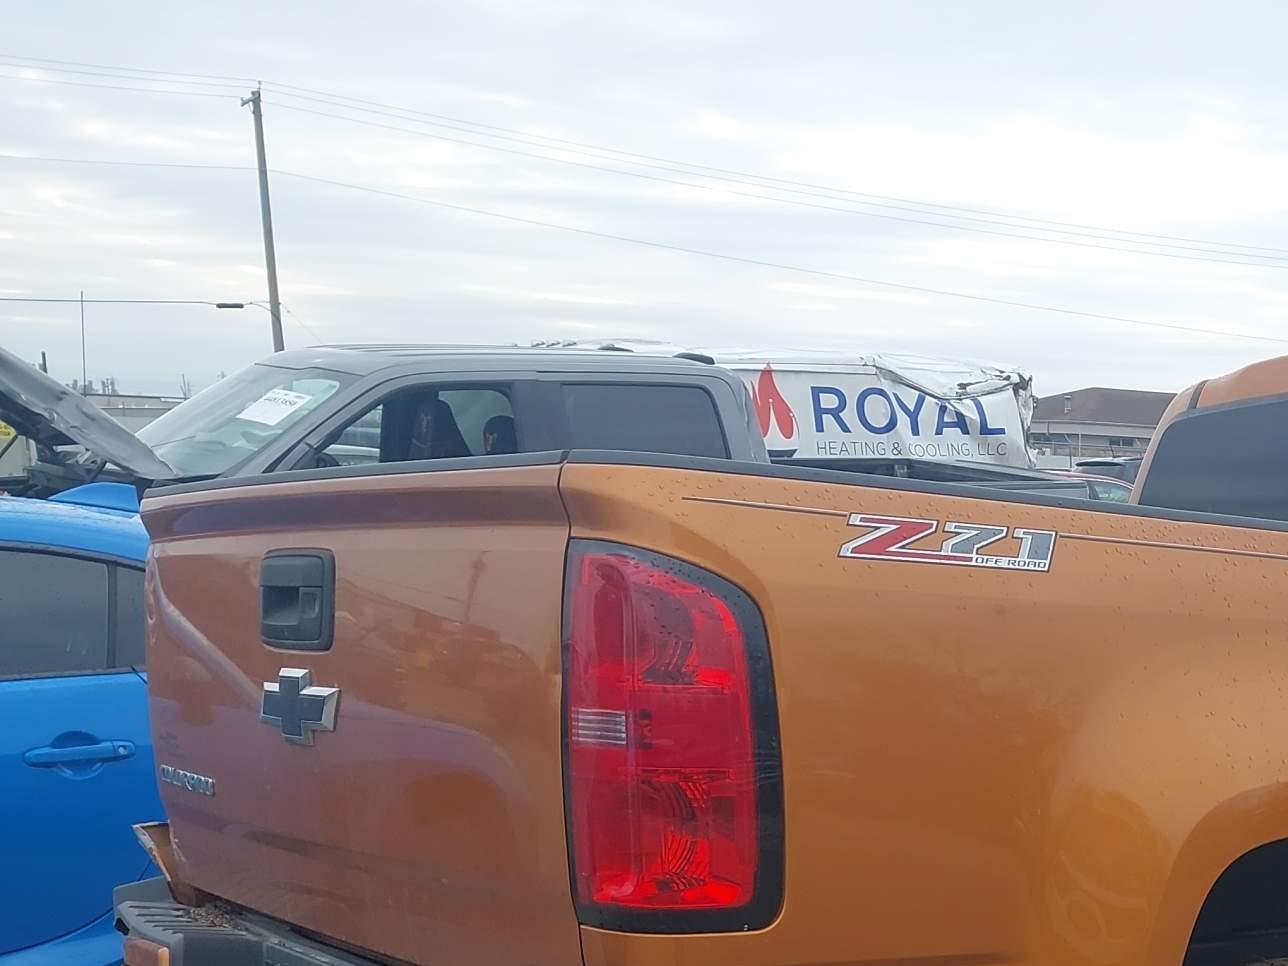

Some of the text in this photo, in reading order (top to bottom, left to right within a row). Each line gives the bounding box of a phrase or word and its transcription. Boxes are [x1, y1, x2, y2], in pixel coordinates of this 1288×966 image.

[810, 385, 1006, 436] ROYAL
[816, 440, 887, 457] HEATING
[892, 442, 903, 456] &
[977, 443, 1007, 457] LLC
[838, 512, 1057, 573] Z71
[974, 556, 1049, 571] OFF ROAD
